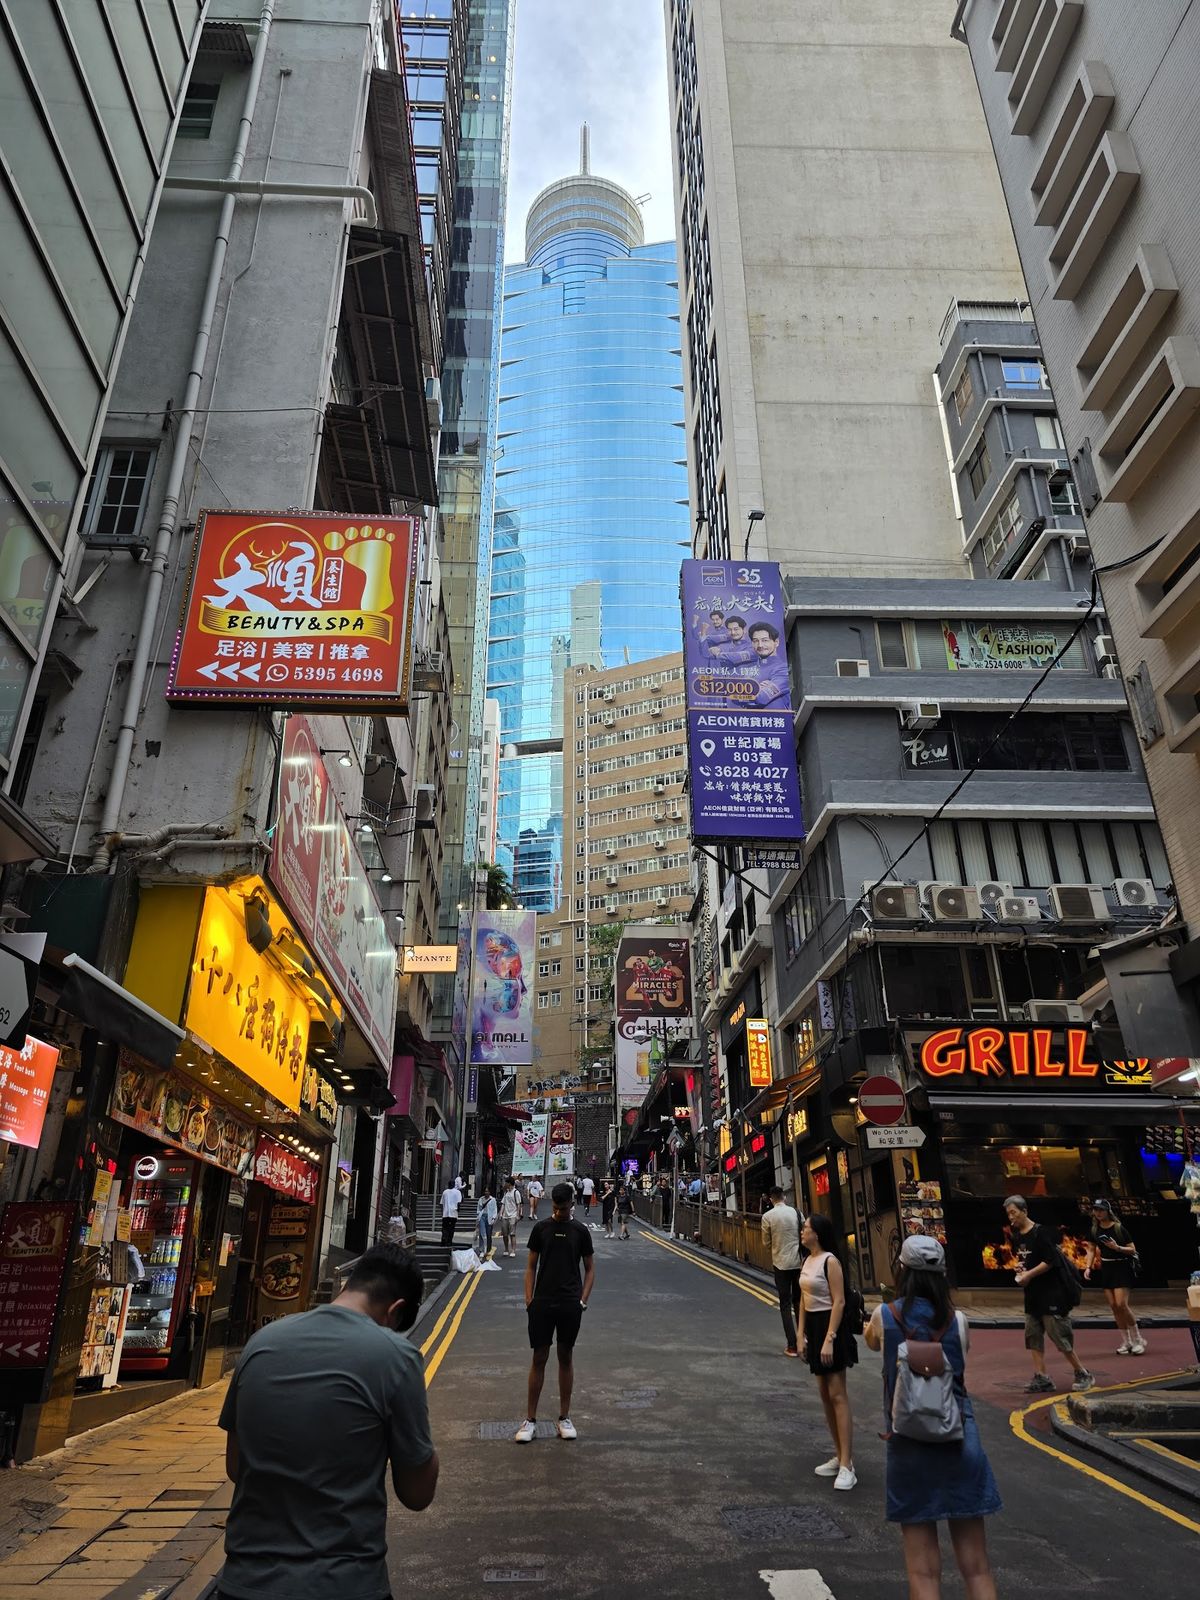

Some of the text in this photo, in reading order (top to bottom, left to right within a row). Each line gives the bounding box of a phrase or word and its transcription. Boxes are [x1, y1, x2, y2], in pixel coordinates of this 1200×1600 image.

[202, 541, 323, 611] 大順
[321, 559, 340, 600] 養生館
[737, 568, 761, 584] 35
[997, 627, 1031, 642] 時裝
[997, 644, 1054, 656] FASHION
[984, 660, 1002, 669] 2524
[1003, 660, 1023, 669] 6008
[294, 666, 384, 682] 5395 4698
[700, 681, 753, 695] $12,000
[723, 736, 782, 750] 世紀廣場
[733, 751, 773, 764] 803室
[714, 766, 789, 779] 3628 4027
[761, 861, 780, 869] 2988
[781, 862, 800, 870] 8348
[633, 981, 678, 989] MIRACLES
[492, 1032, 528, 1042] MALL
[921, 1027, 1098, 1077] GRILL
[879, 1136, 905, 1145] 和安里
